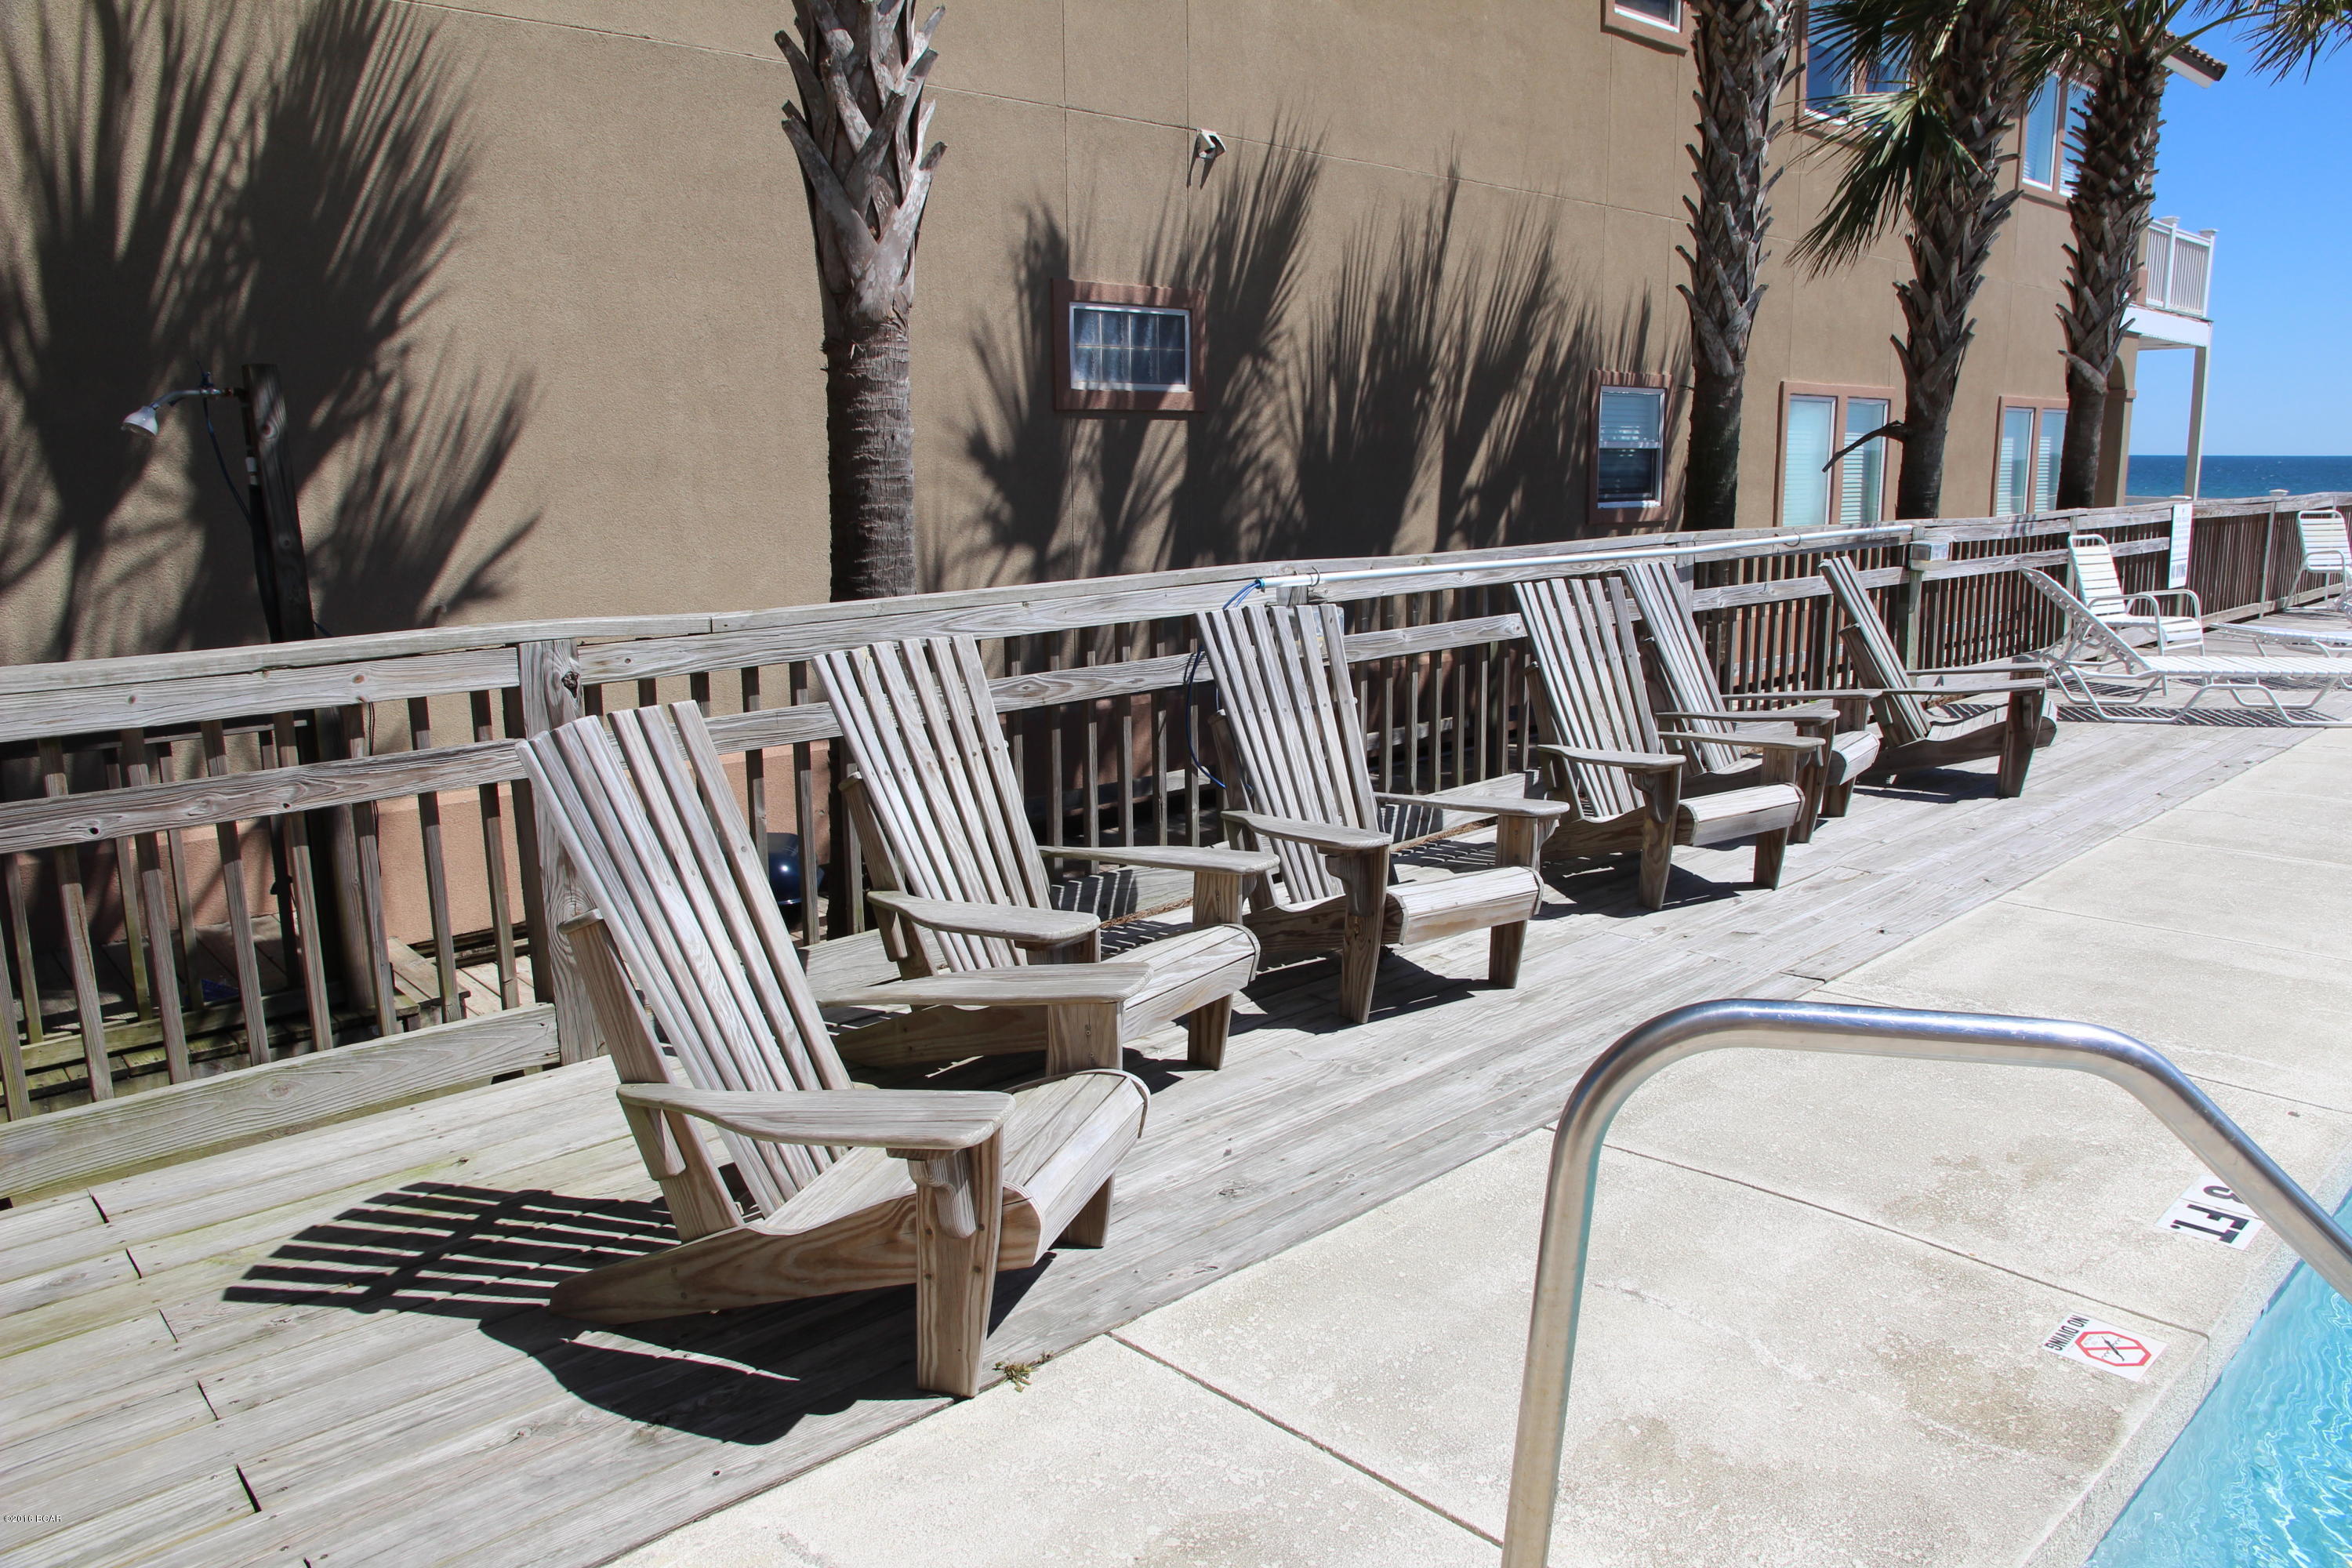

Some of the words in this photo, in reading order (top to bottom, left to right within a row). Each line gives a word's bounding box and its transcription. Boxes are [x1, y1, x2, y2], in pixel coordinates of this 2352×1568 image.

[2169, 1203, 2249, 1243] FT.
[2067, 1314, 2089, 1328] NO
[2044, 1327, 2080, 1351] DIVING
